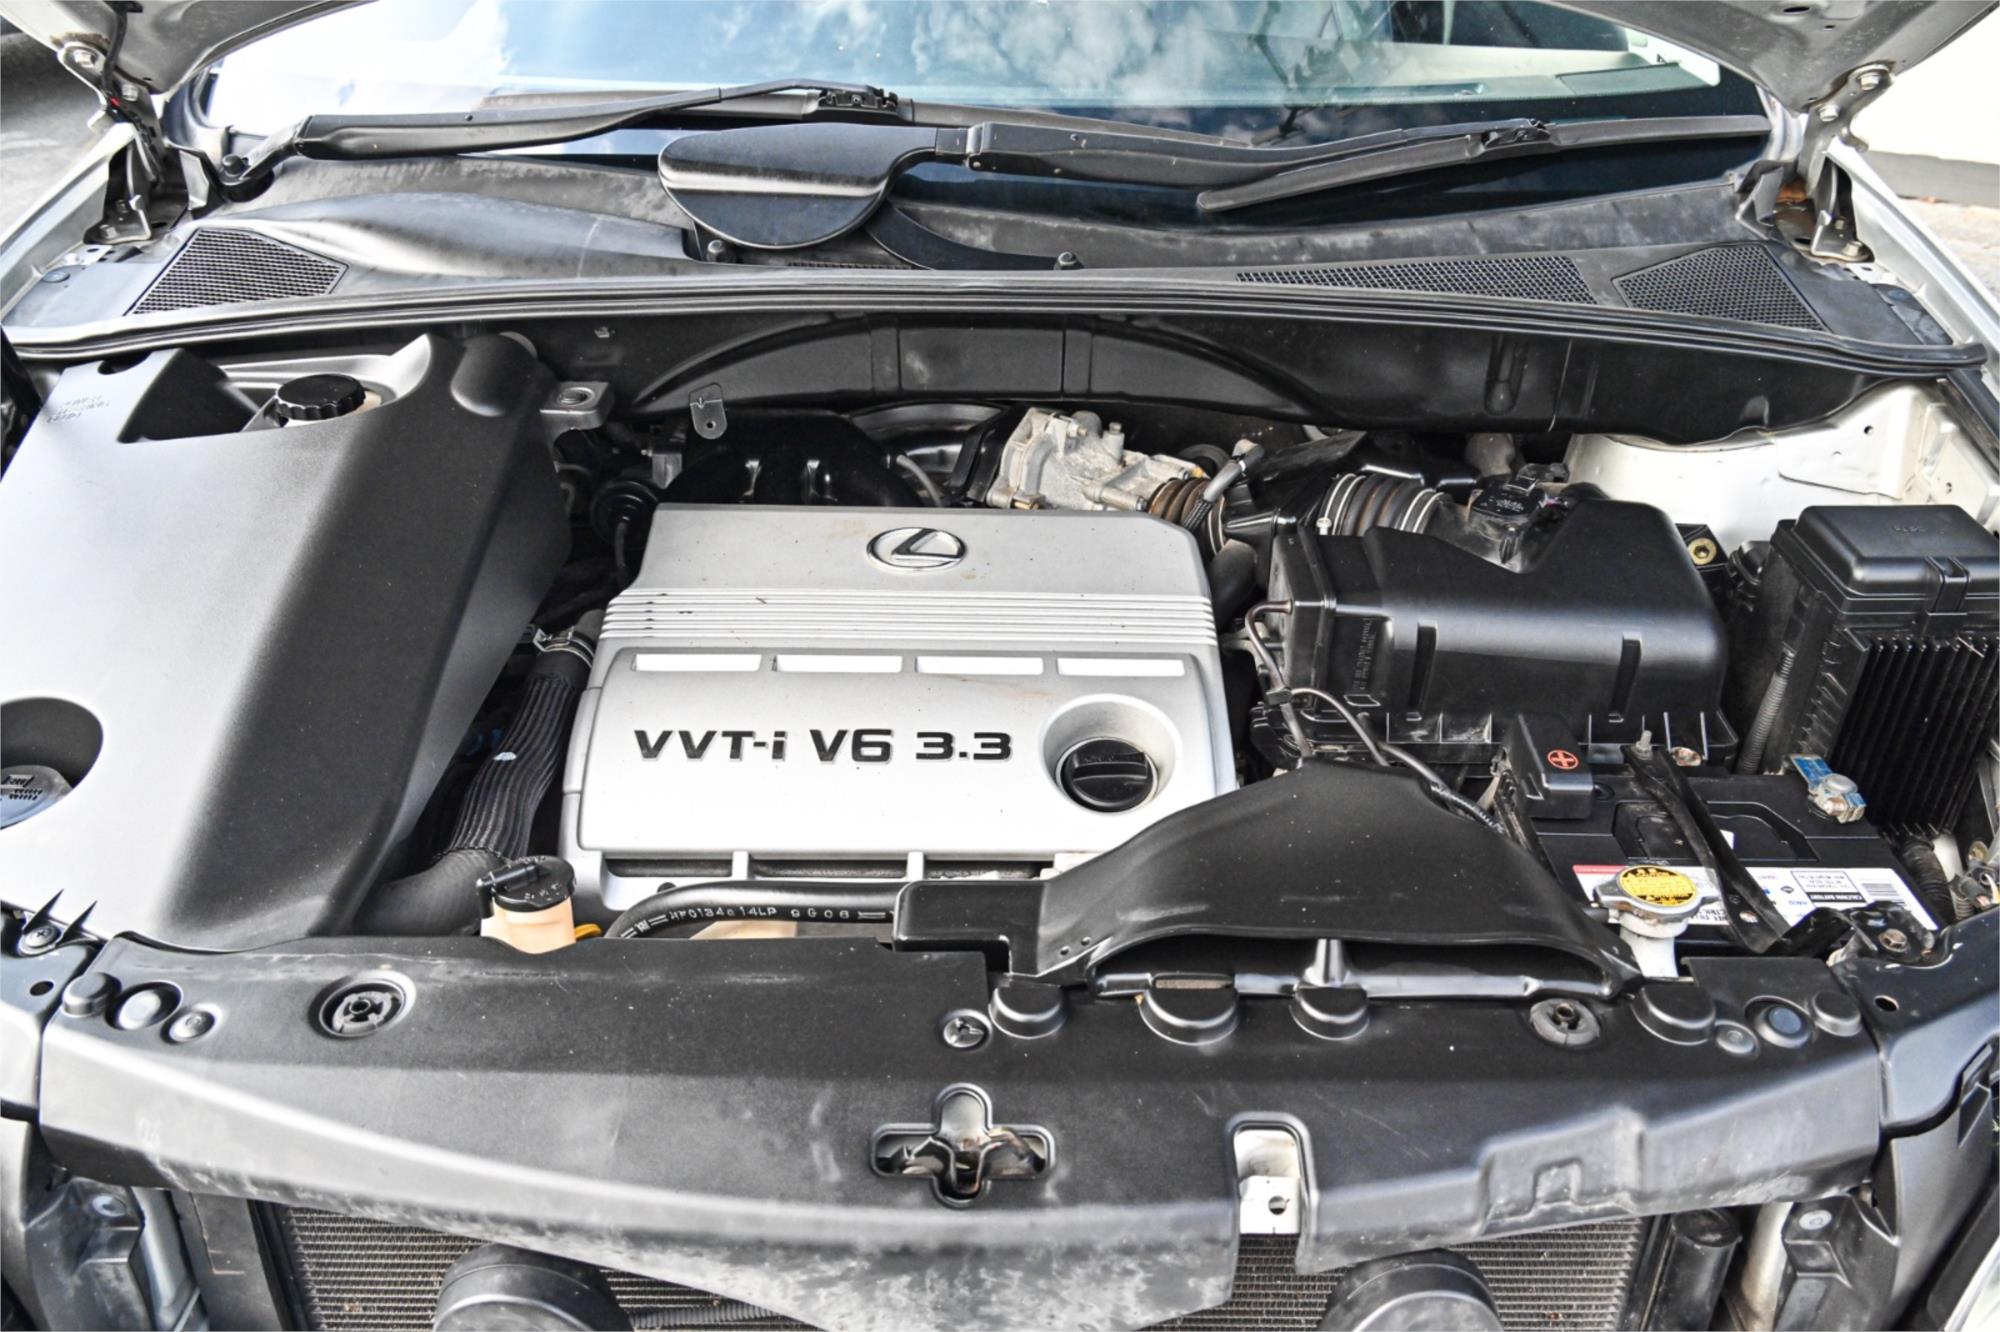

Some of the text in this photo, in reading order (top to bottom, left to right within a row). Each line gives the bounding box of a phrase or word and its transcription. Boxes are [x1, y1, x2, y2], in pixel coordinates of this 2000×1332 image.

[634, 728, 1012, 763] VVT-i V6 3.3
